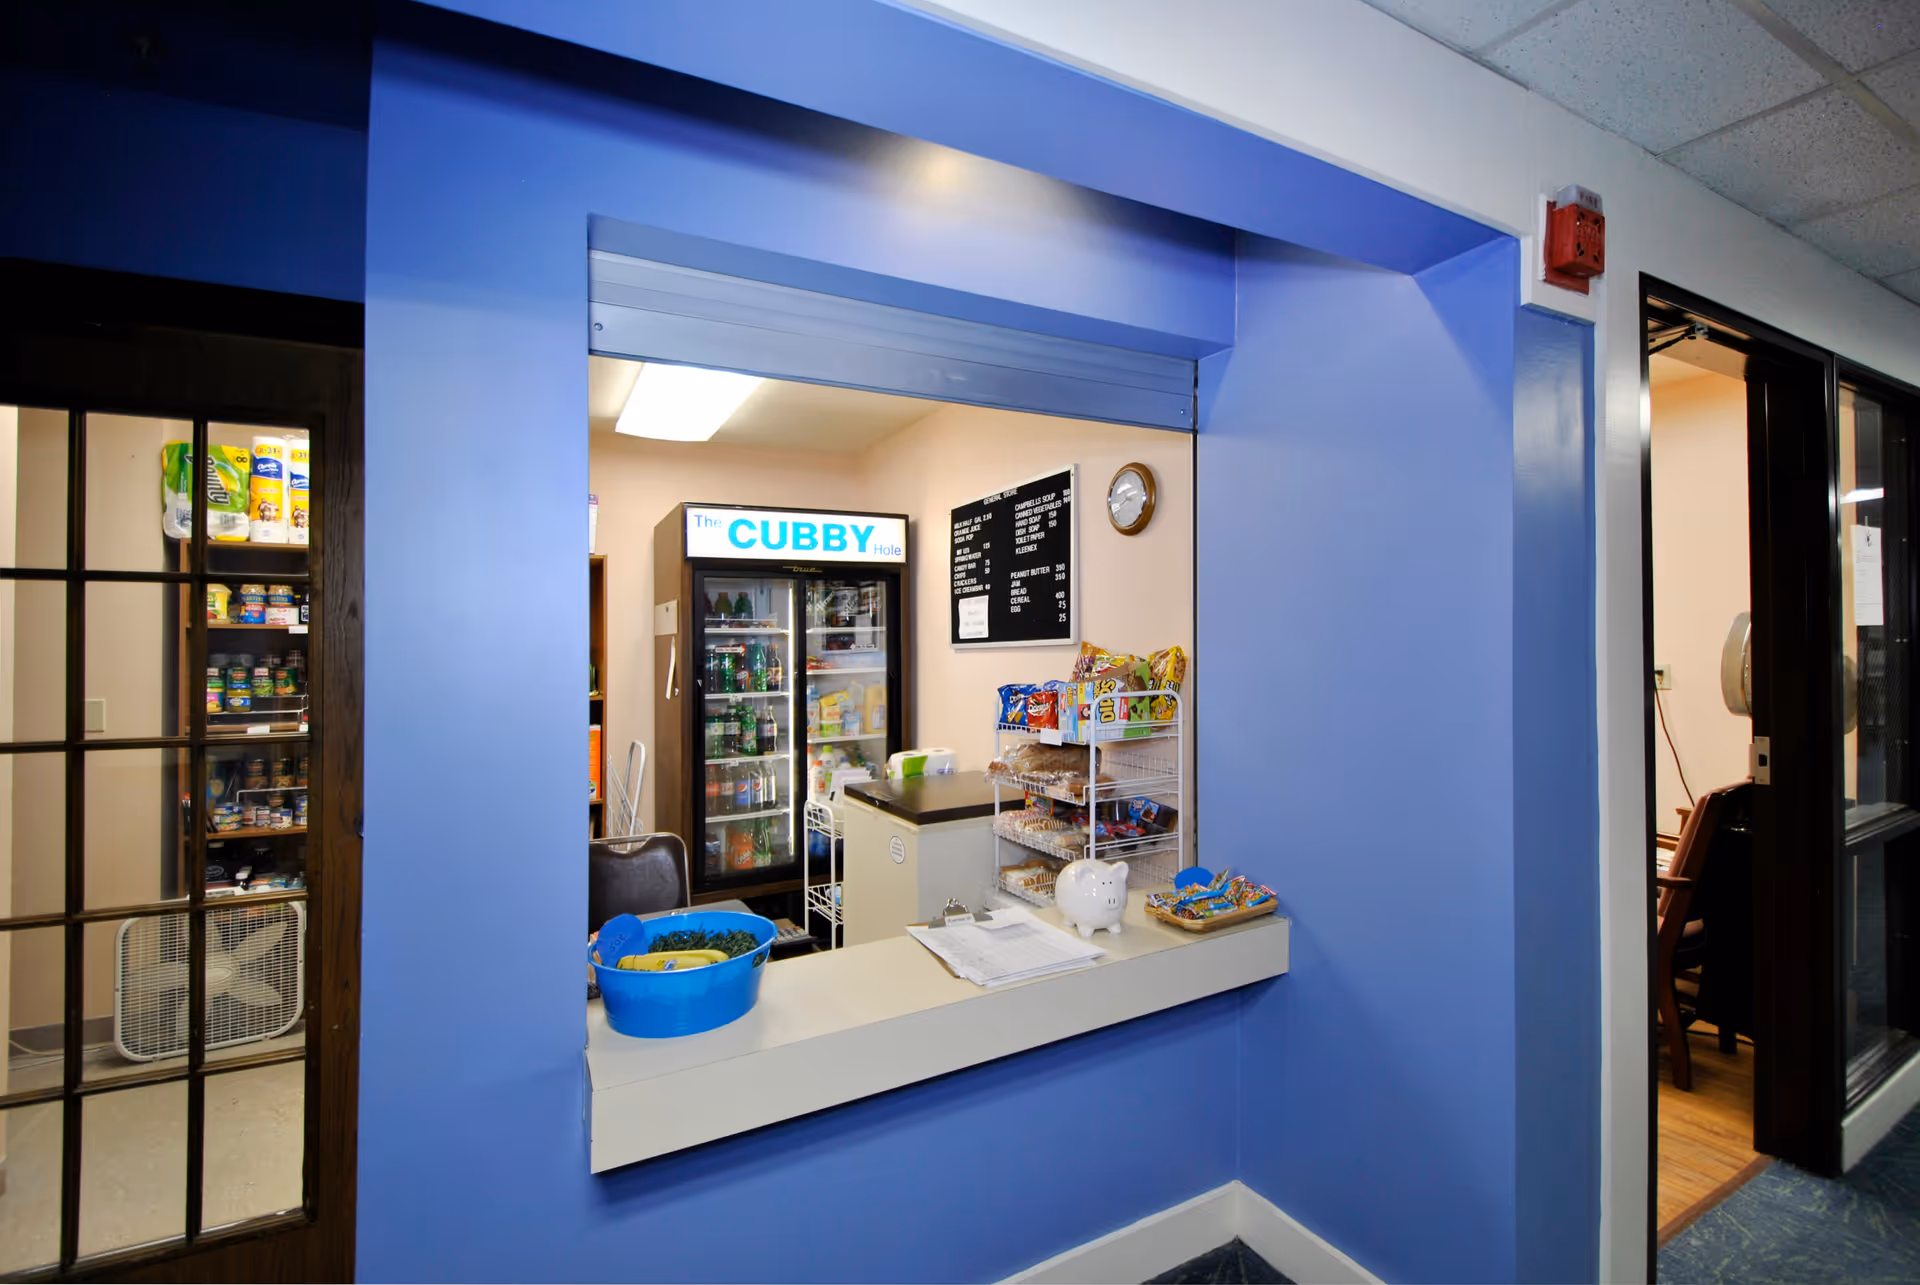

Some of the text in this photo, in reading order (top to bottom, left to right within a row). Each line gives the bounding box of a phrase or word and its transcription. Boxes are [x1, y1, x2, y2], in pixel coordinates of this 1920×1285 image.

[1015, 496, 1042, 511] CAMPBELLS
[1042, 492, 1056, 503] SOUP
[1015, 508, 1033, 520] CANNED
[1033, 499, 1062, 515] VEGETABLES
[1015, 518, 1028, 528] HAND
[1028, 514, 1042, 525] SOAP
[694, 514, 902, 557] The CUBBY Hole
[1015, 527, 1027, 537] DISH
[1028, 523, 1040, 533] SOAP
[1015, 531, 1045, 545] TOILET PAPER
[1015, 543, 1038, 555] KLEENEX
[1010, 569, 1030, 579] PEANUT
[1030, 565, 1050, 576] BUTTER
[954, 577, 977, 588] CRACKERS
[1010, 580, 1021, 588] JAM
[954, 587, 962, 595] ICE
[1010, 587, 1027, 596] BREAD
[1010, 596, 1031, 605] CEREAL
[1010, 605, 1021, 613] EGG
[1058, 613, 1066, 622] 25
